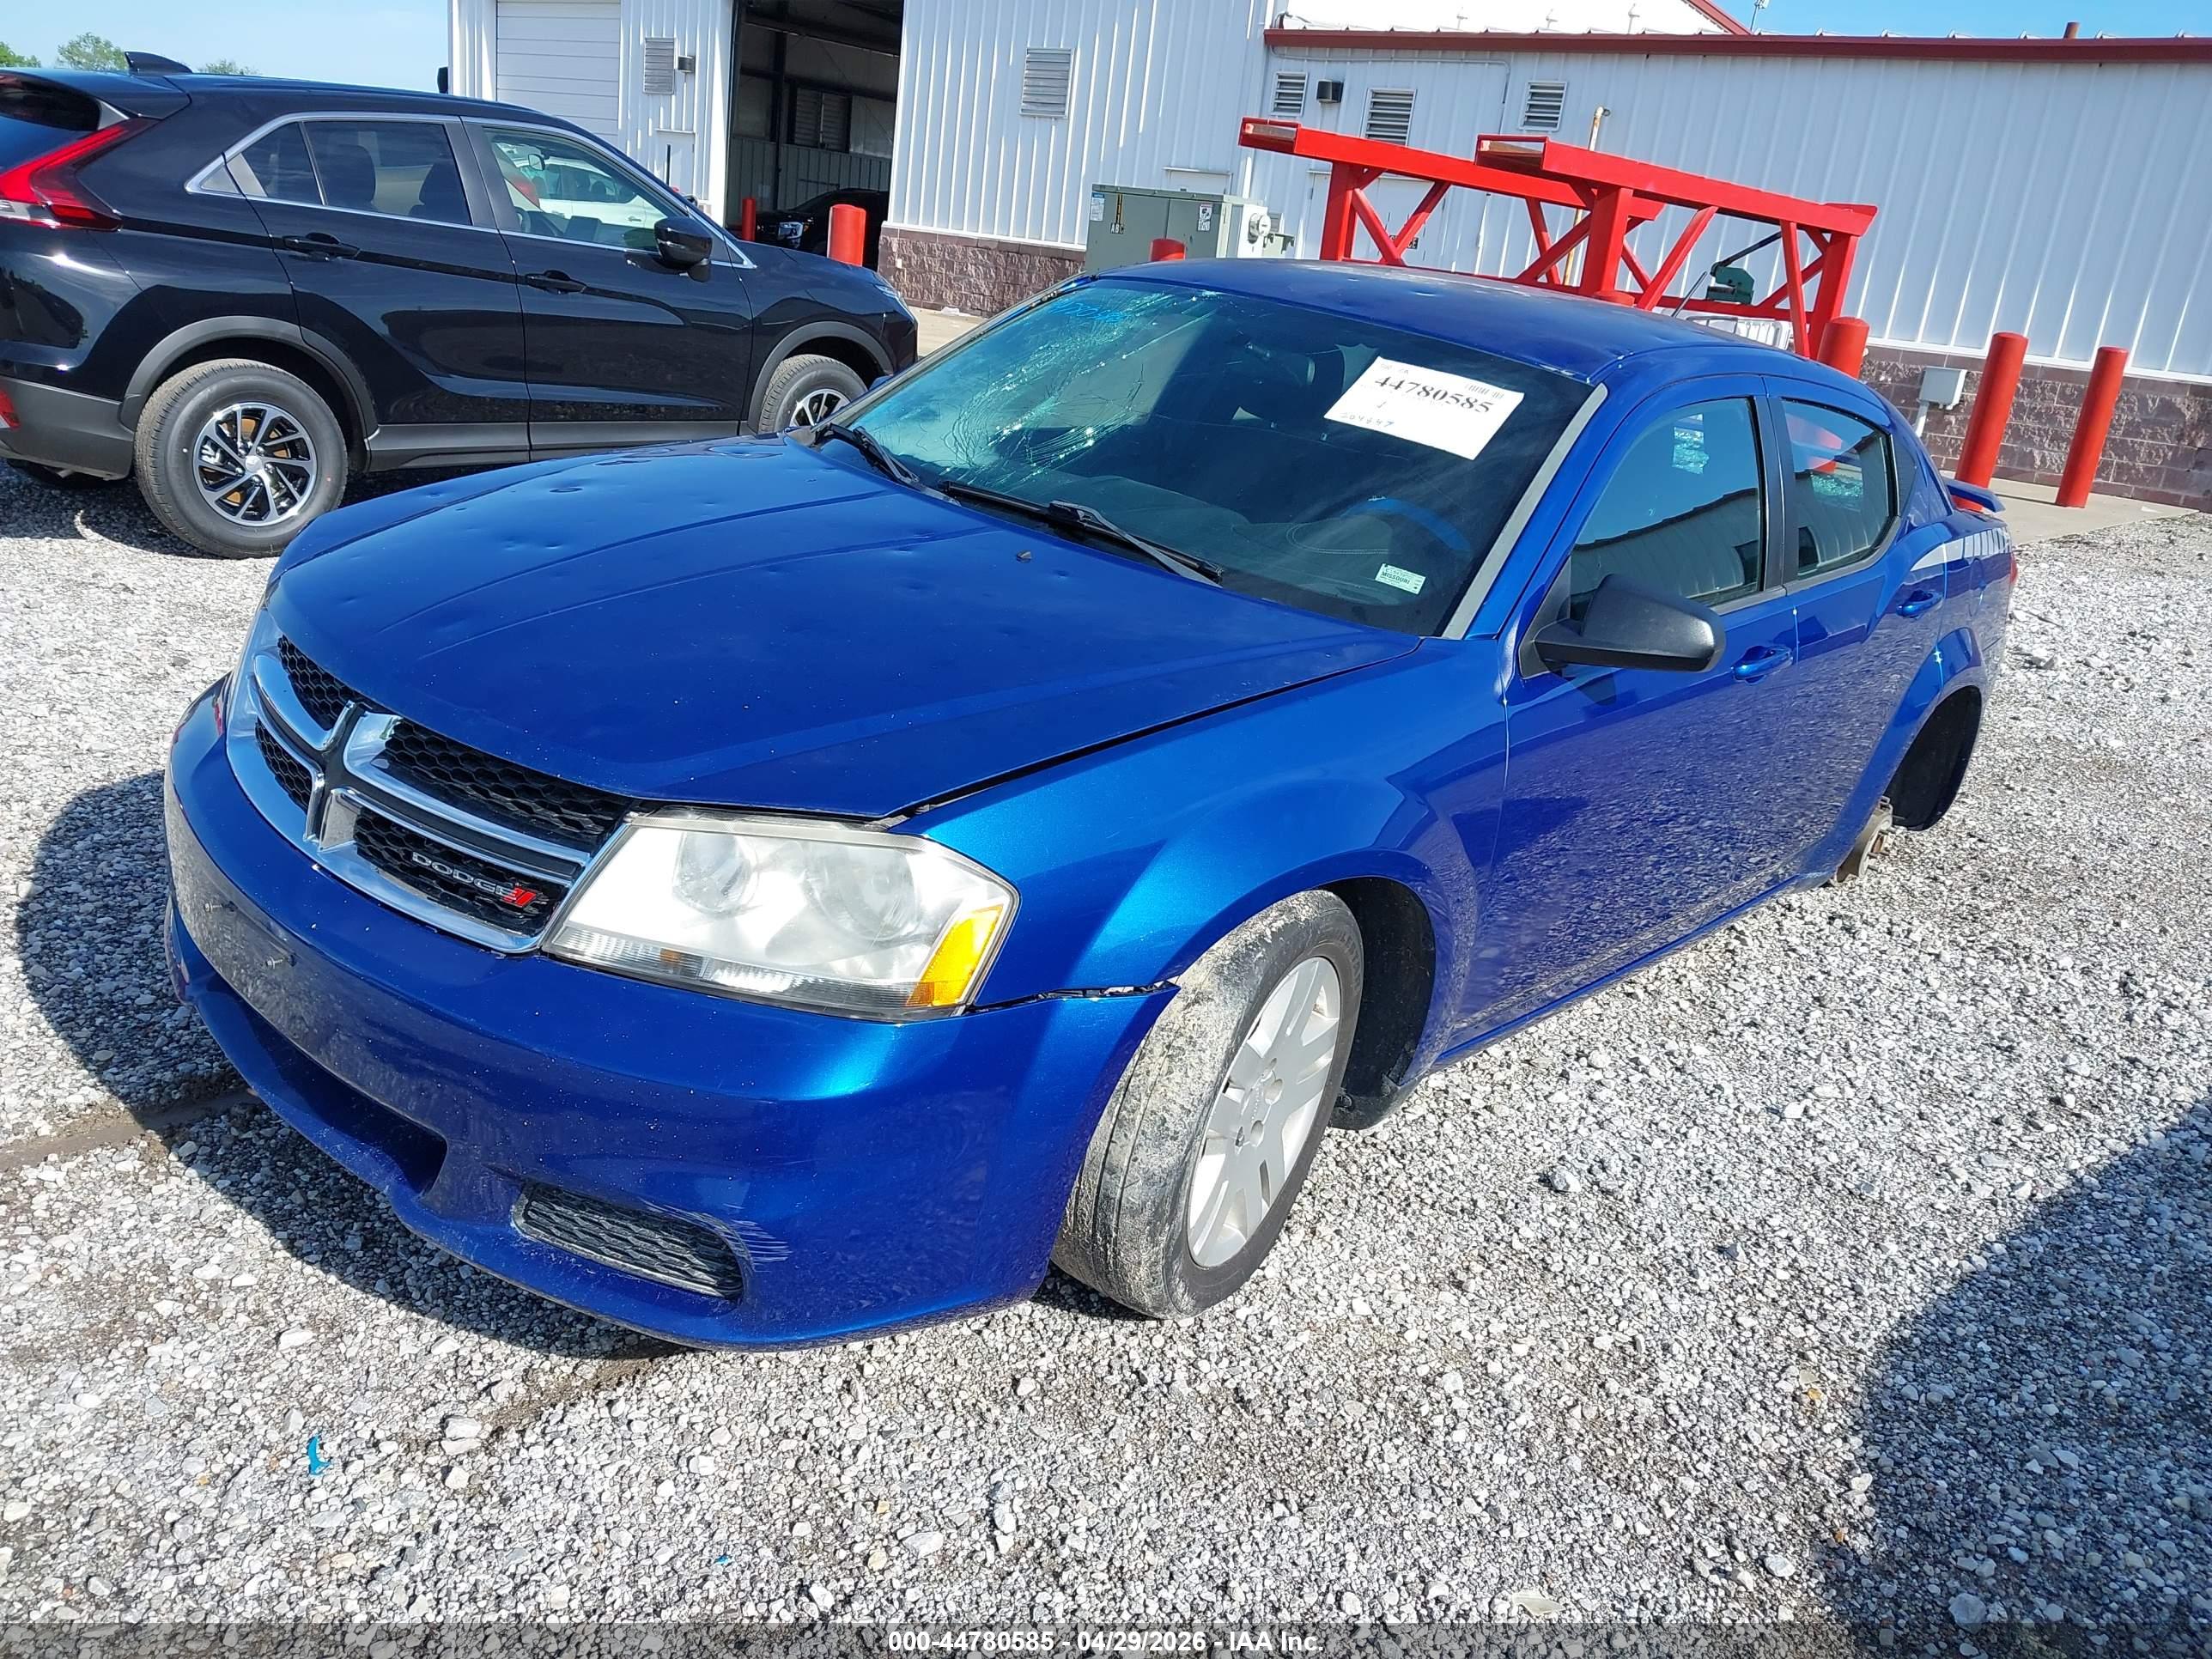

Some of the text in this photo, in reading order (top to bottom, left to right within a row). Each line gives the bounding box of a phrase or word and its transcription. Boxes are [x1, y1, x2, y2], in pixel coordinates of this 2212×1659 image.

[1110, 222, 1124, 234] ABC
[1375, 375, 1495, 414] 44780585
[1380, 571, 1411, 584] MISSOURI
[412, 851, 517, 900] DODGE
